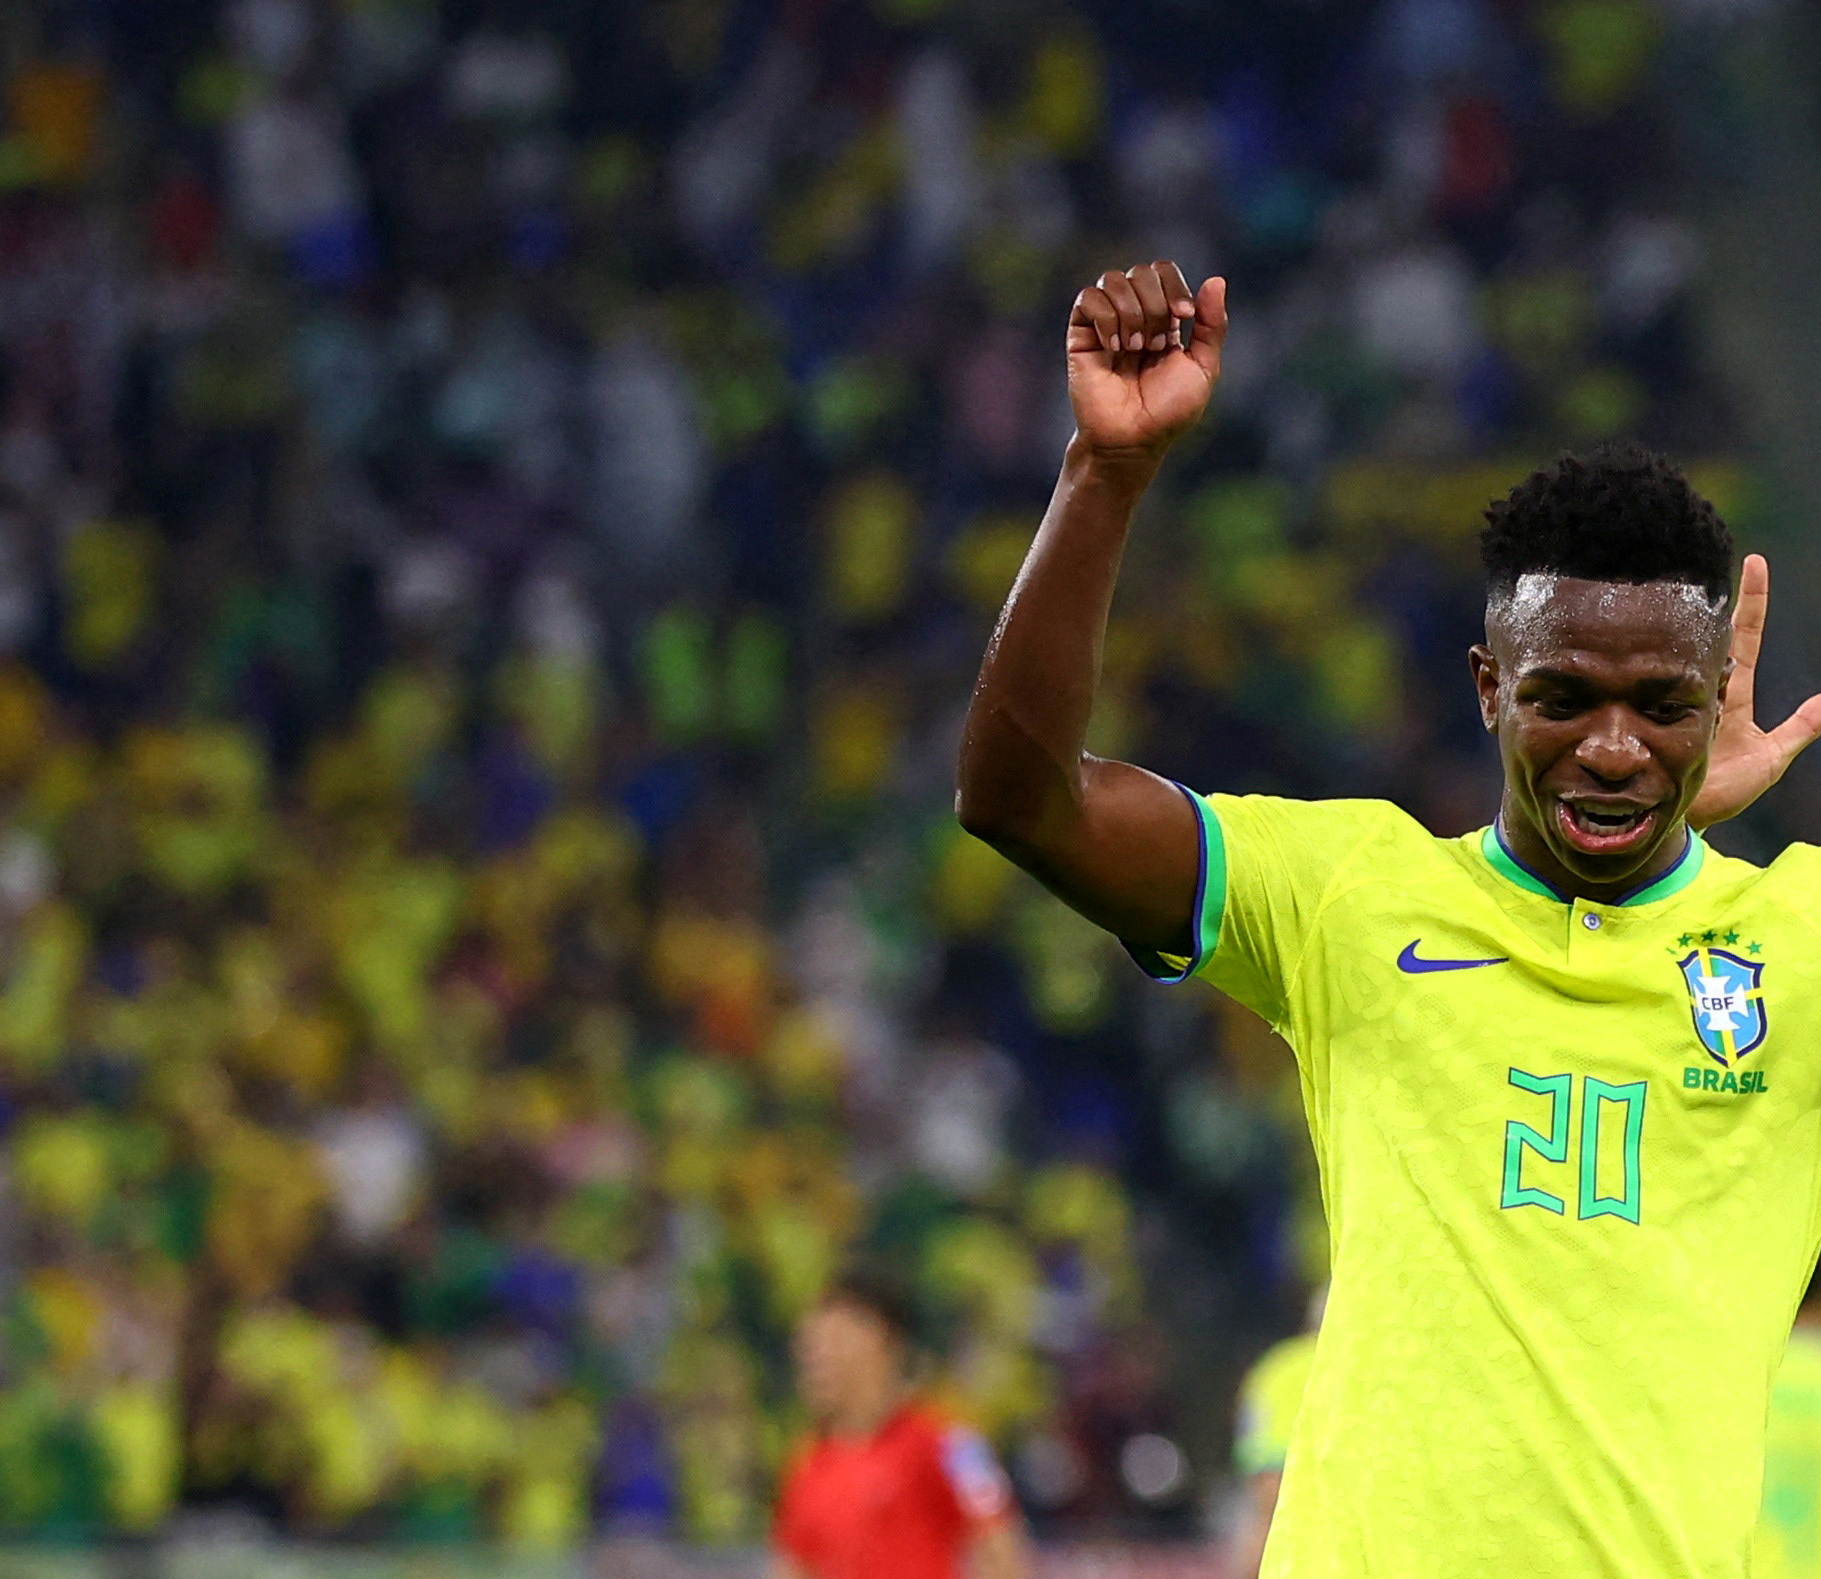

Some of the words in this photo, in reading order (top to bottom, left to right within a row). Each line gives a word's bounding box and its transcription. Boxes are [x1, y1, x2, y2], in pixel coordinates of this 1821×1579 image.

[1701, 996, 1734, 1011] CBF
[1682, 1067, 1769, 1094] BRASIL
[1499, 1066, 1648, 1226] 20
